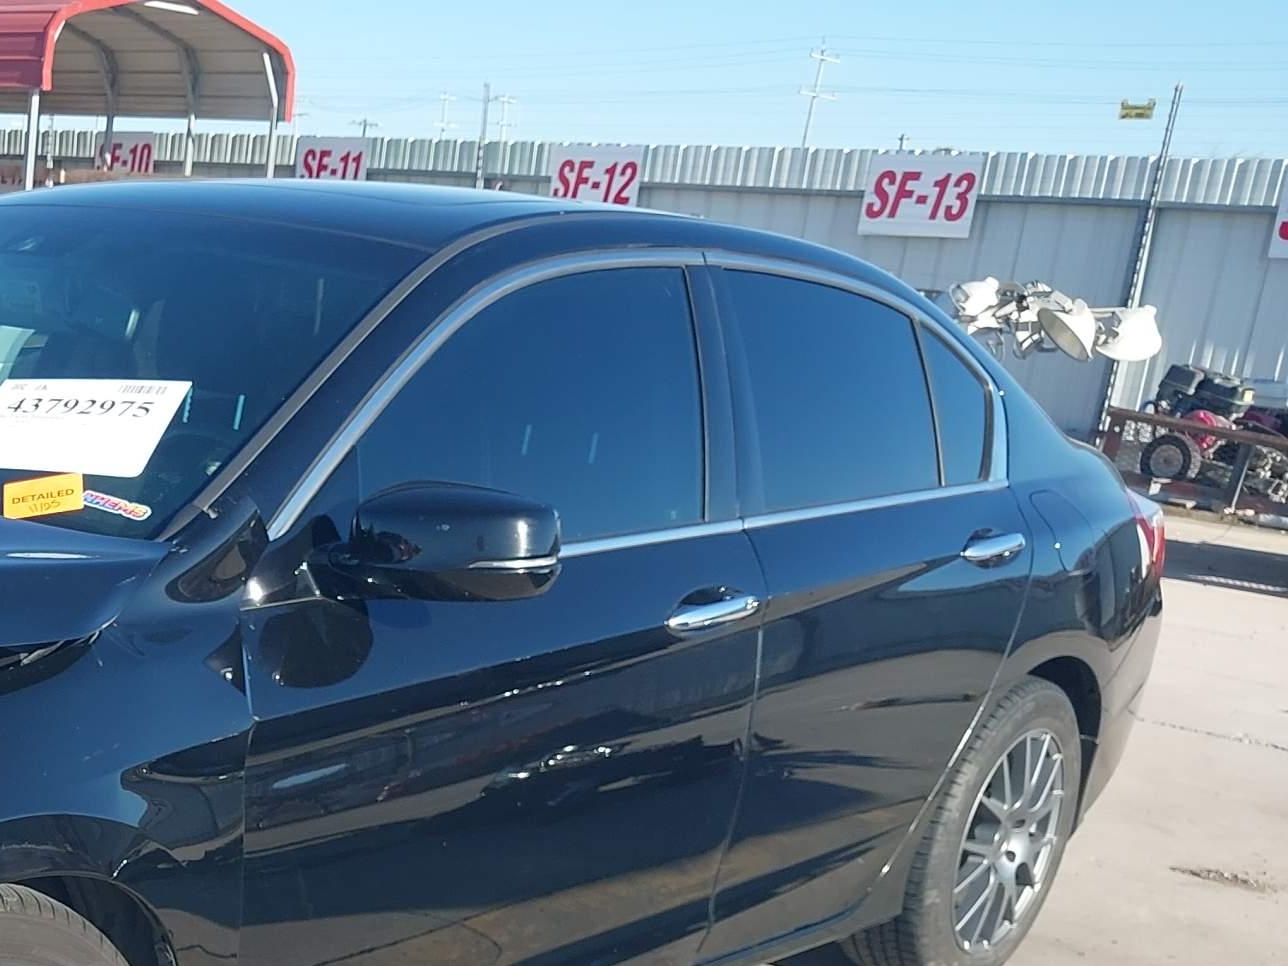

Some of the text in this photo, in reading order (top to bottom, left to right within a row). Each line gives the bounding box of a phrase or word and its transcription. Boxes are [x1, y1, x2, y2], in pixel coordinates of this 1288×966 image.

[300, 148, 363, 180] SF-11
[552, 159, 638, 206] SF-12
[864, 169, 977, 222] SF-13
[7, 397, 155, 418] 43792975
[11, 487, 75, 505] DETAILED
